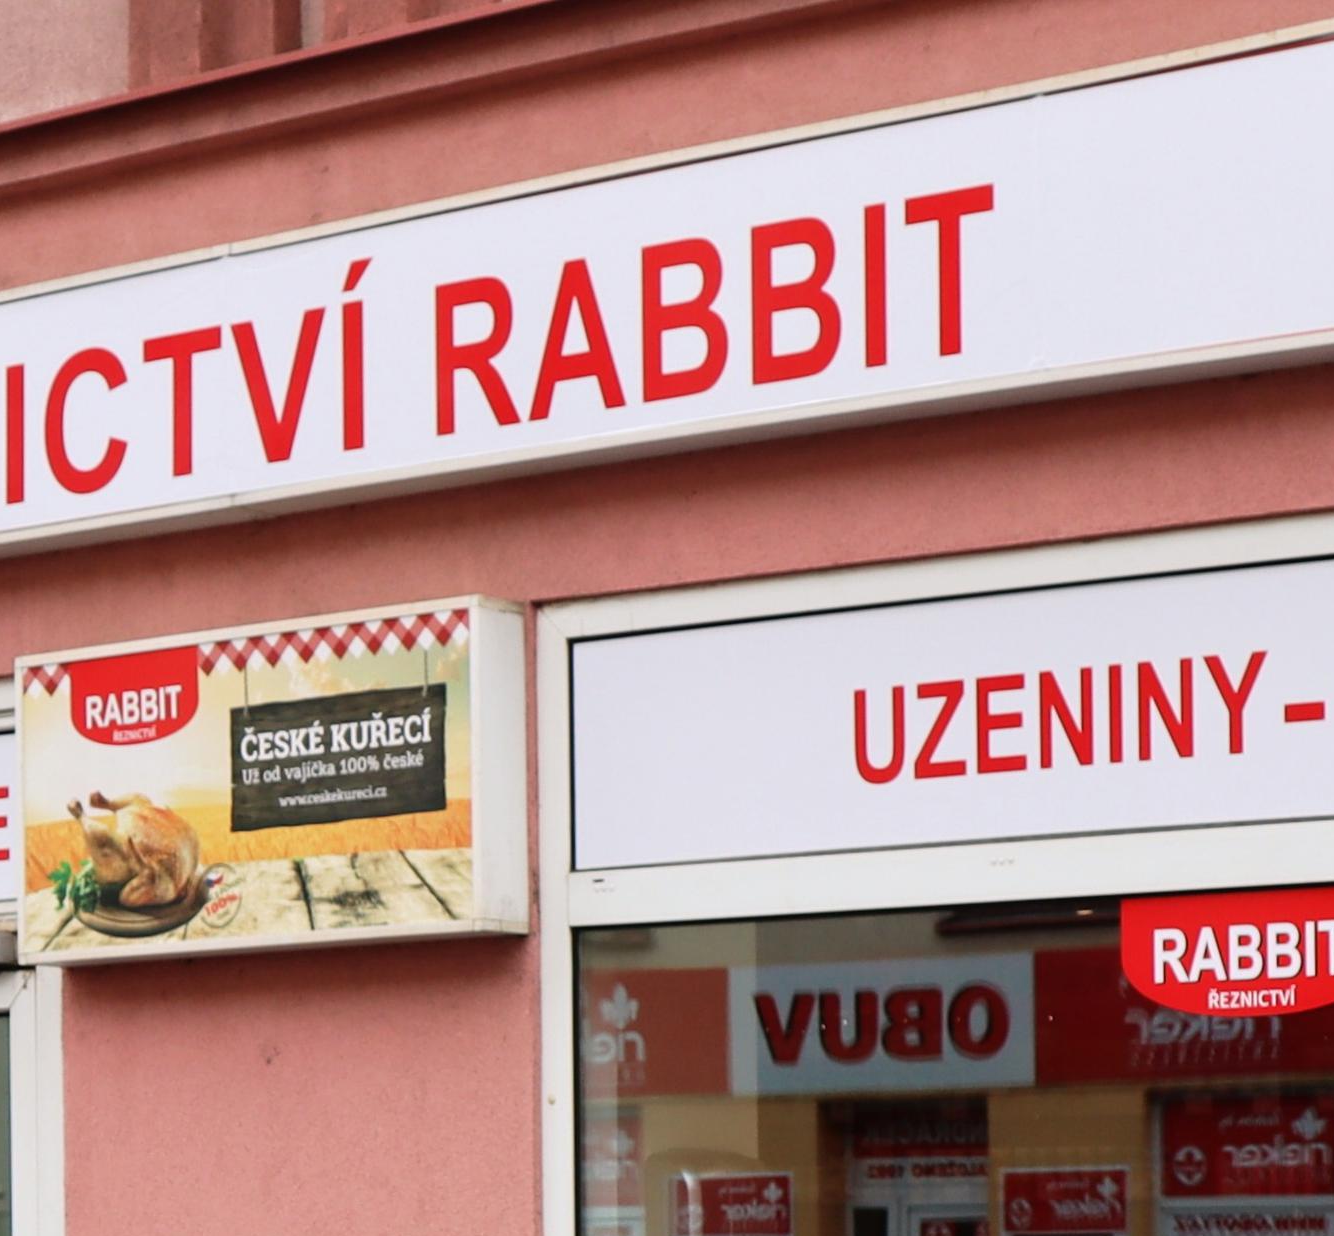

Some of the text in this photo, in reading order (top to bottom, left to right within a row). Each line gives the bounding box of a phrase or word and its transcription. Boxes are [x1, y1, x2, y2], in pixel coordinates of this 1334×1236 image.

[434, 183, 995, 437] RABBIT
[85, 684, 183, 730] RABBIT
[240, 706, 433, 763] ČESKÉ KUŘECÍ
[241, 749, 425, 785] Už od vajíčka 100% české
[1208, 984, 1297, 1009] ŘEZNICTVÍ
